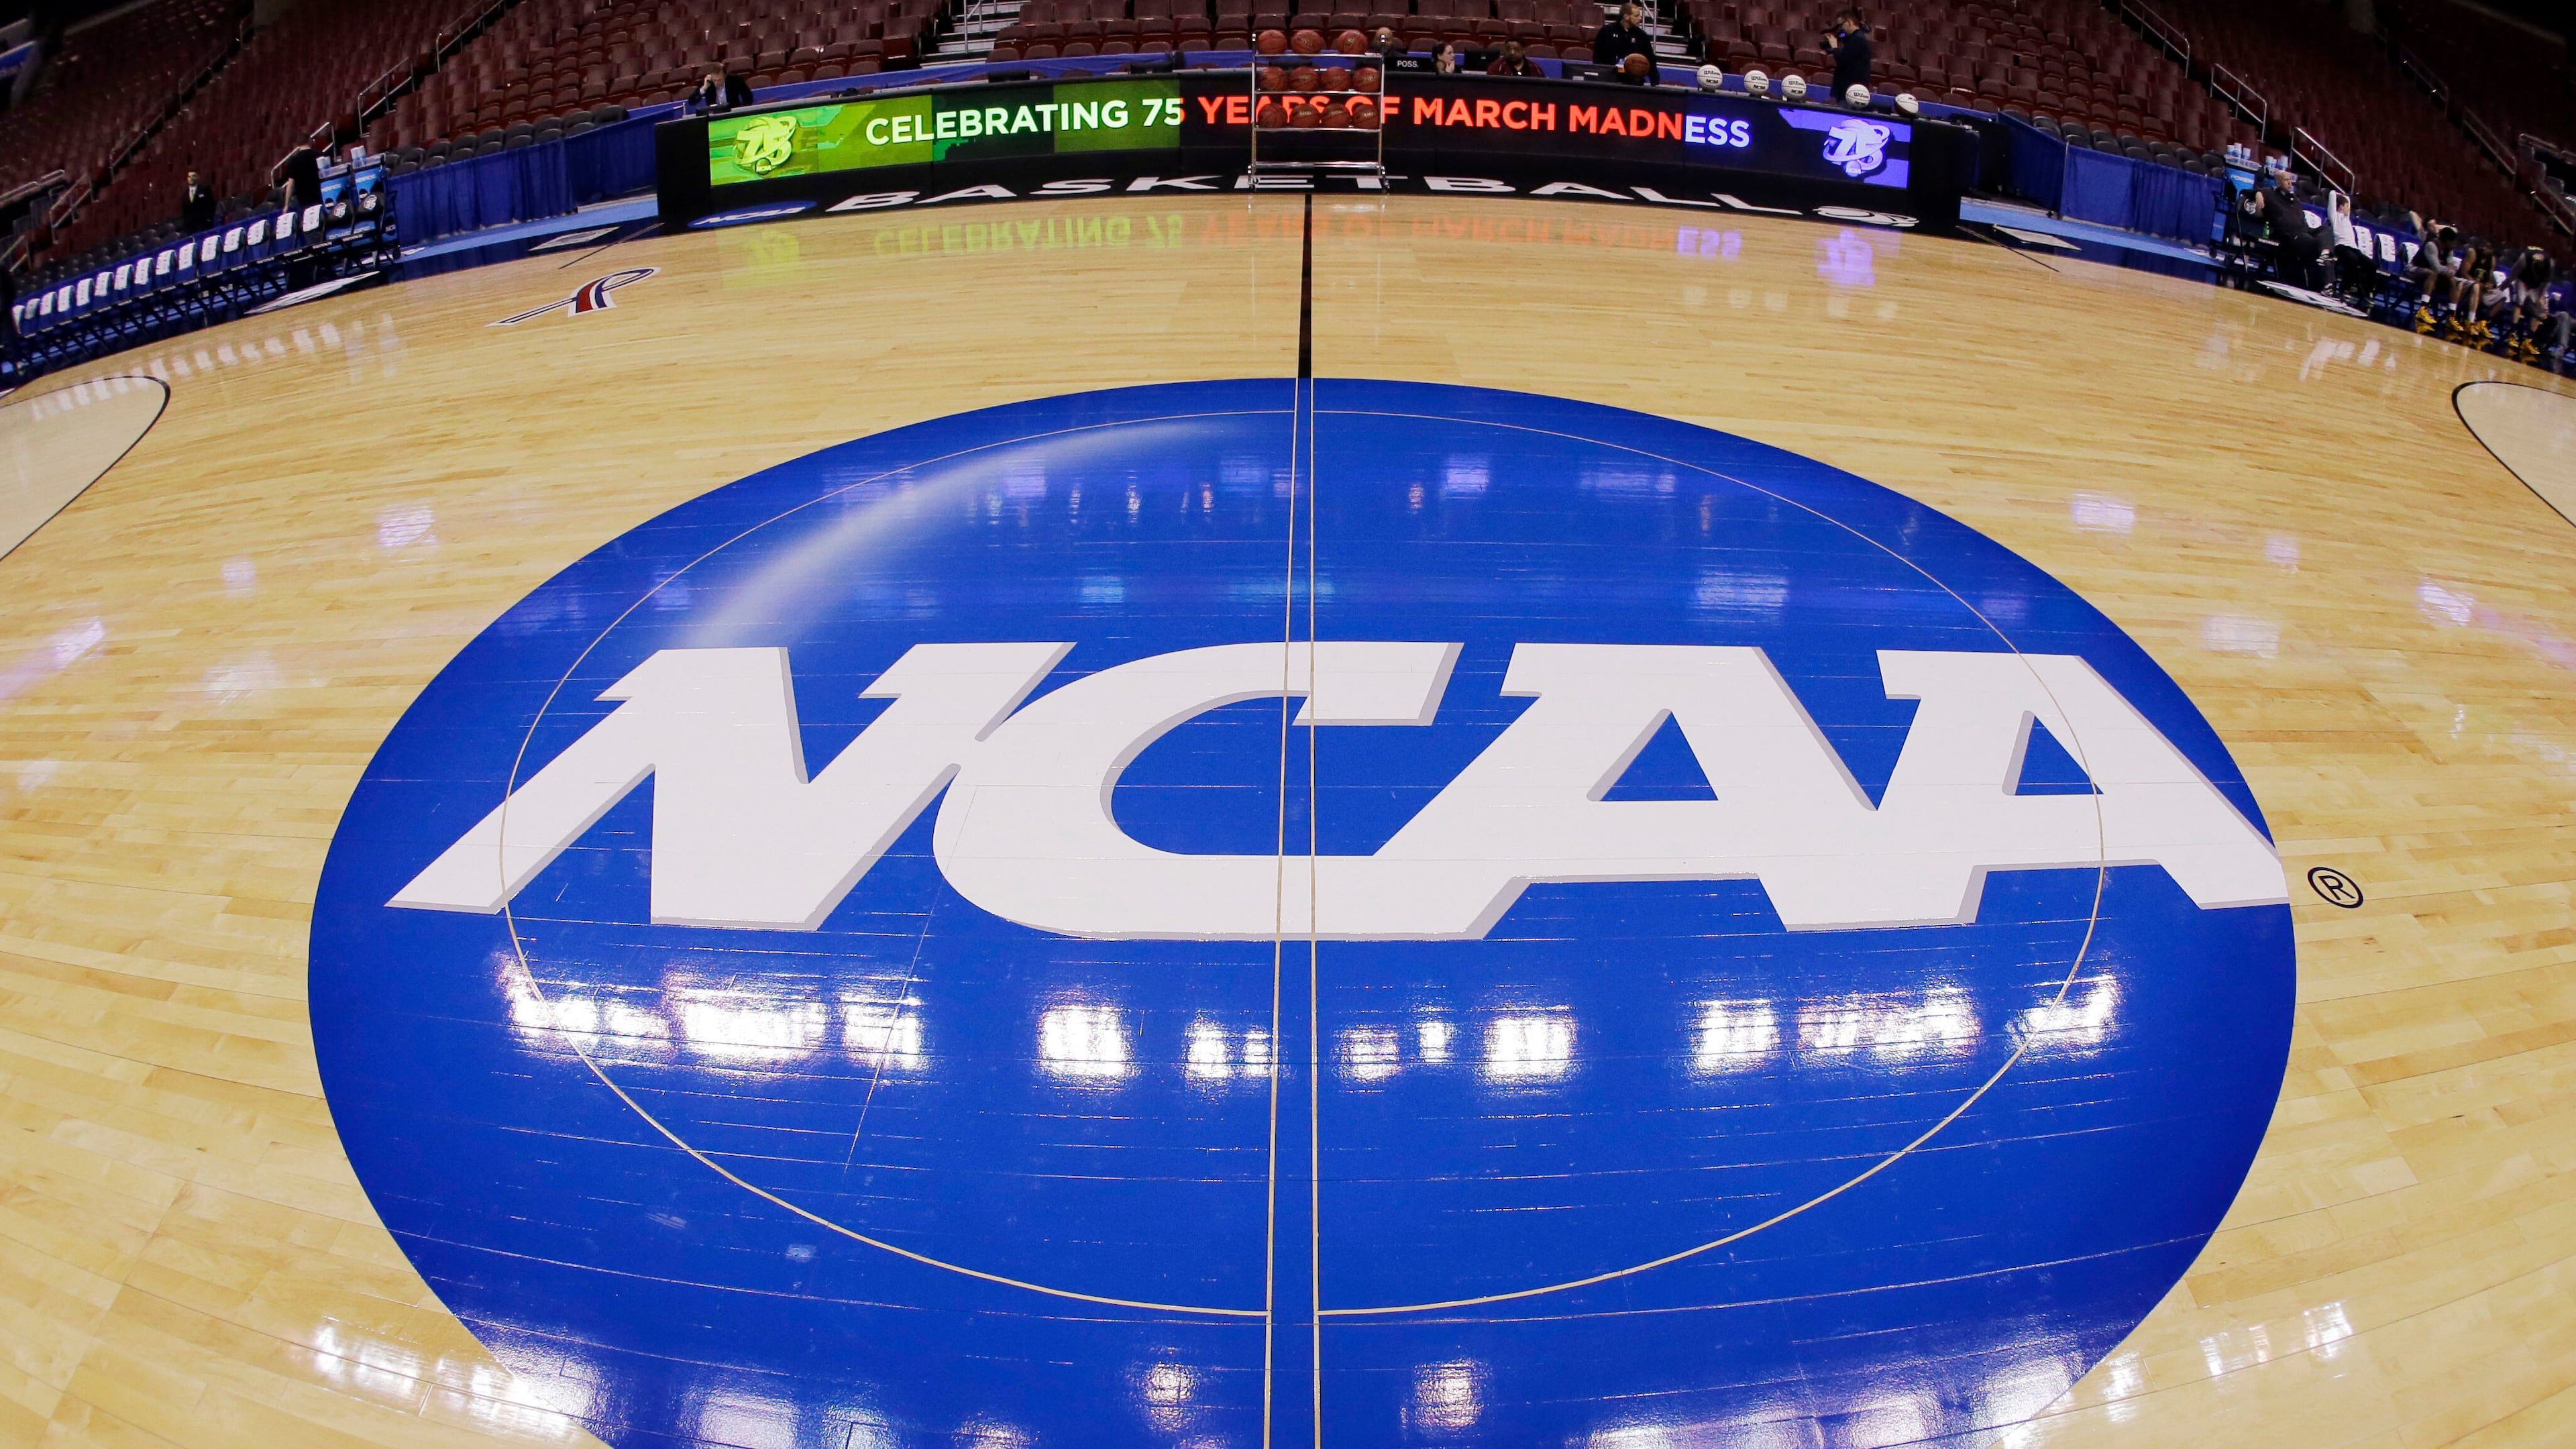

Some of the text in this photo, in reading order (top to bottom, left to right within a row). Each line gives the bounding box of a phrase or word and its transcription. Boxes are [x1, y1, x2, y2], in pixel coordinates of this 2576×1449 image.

[866, 100, 1128, 145] CELEBRATING
[1142, 98, 1185, 127] 75
[1413, 97, 1556, 131] MARCH
[1569, 105, 1751, 148] MADNESS
[825, 176, 1803, 215] BASKETBALL
[383, 640, 2290, 943] NCAA
